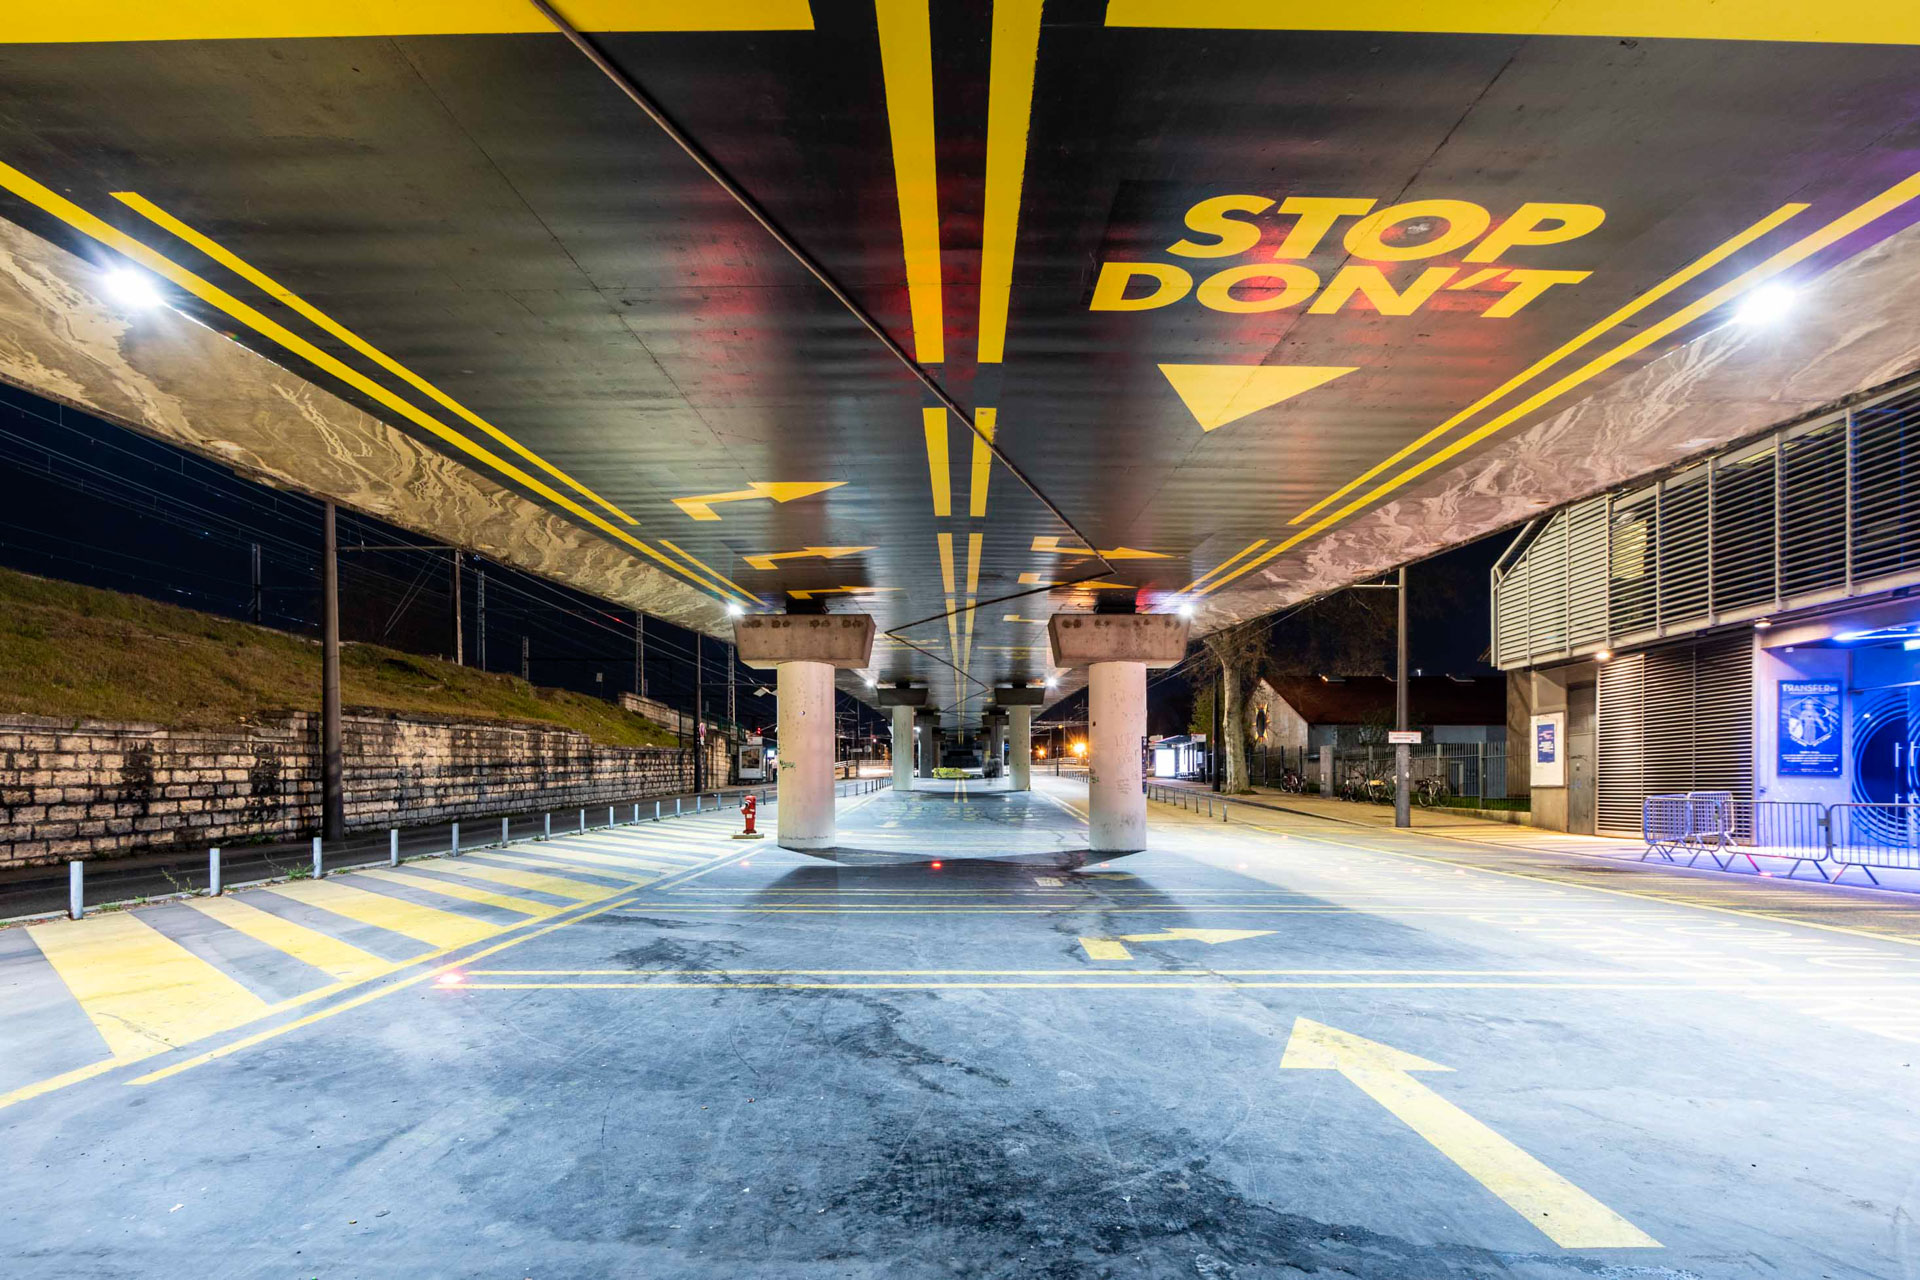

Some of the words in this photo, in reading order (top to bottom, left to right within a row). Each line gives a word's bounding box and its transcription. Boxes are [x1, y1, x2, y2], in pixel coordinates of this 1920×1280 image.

[1166, 194, 1606, 263] STOP
[1089, 262, 1595, 318] DON'T
[1782, 684, 1830, 692] TRANSFER
[1468, 914, 1782, 971] STRIP
